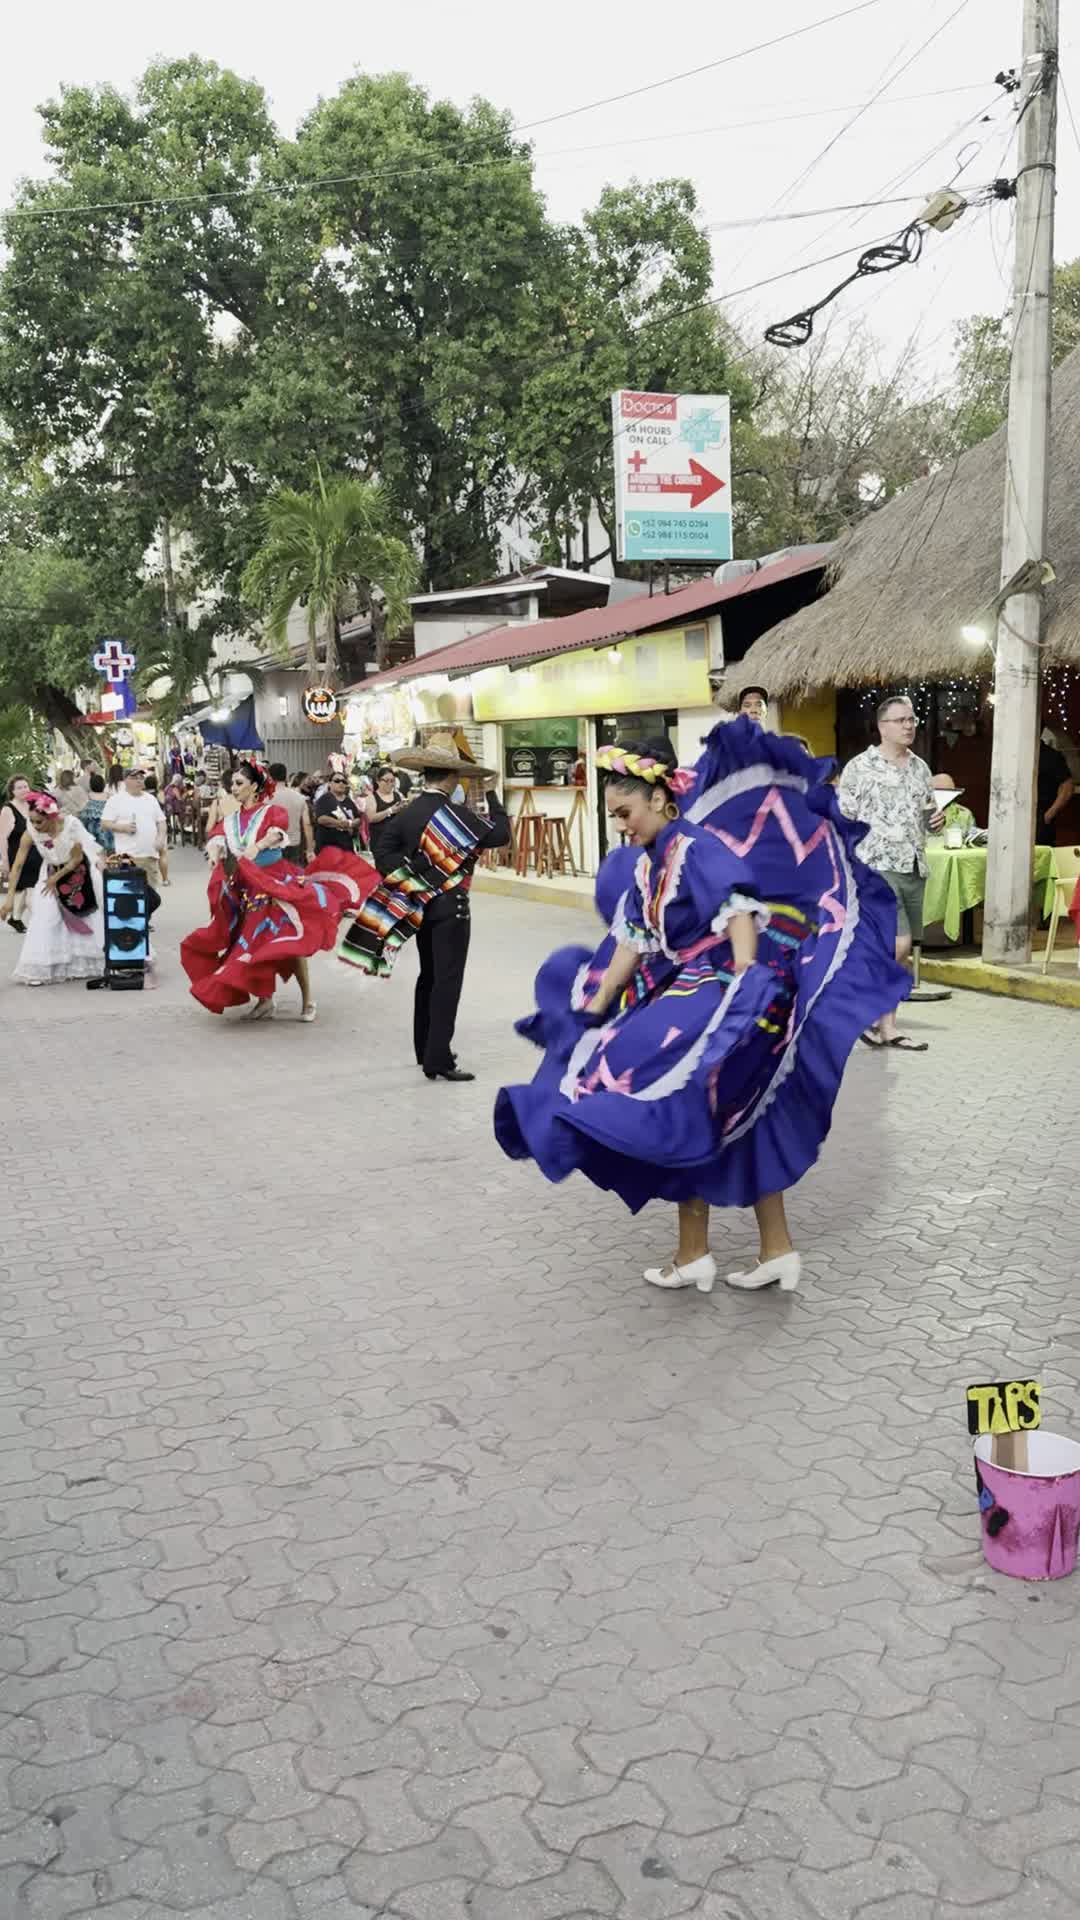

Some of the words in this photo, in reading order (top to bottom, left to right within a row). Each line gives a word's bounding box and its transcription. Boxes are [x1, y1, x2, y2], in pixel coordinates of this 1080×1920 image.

[625, 424, 637, 433] 24
[639, 425, 672, 435] HOURS
[629, 435, 643, 445] ON
[646, 436, 668, 445] CALL
